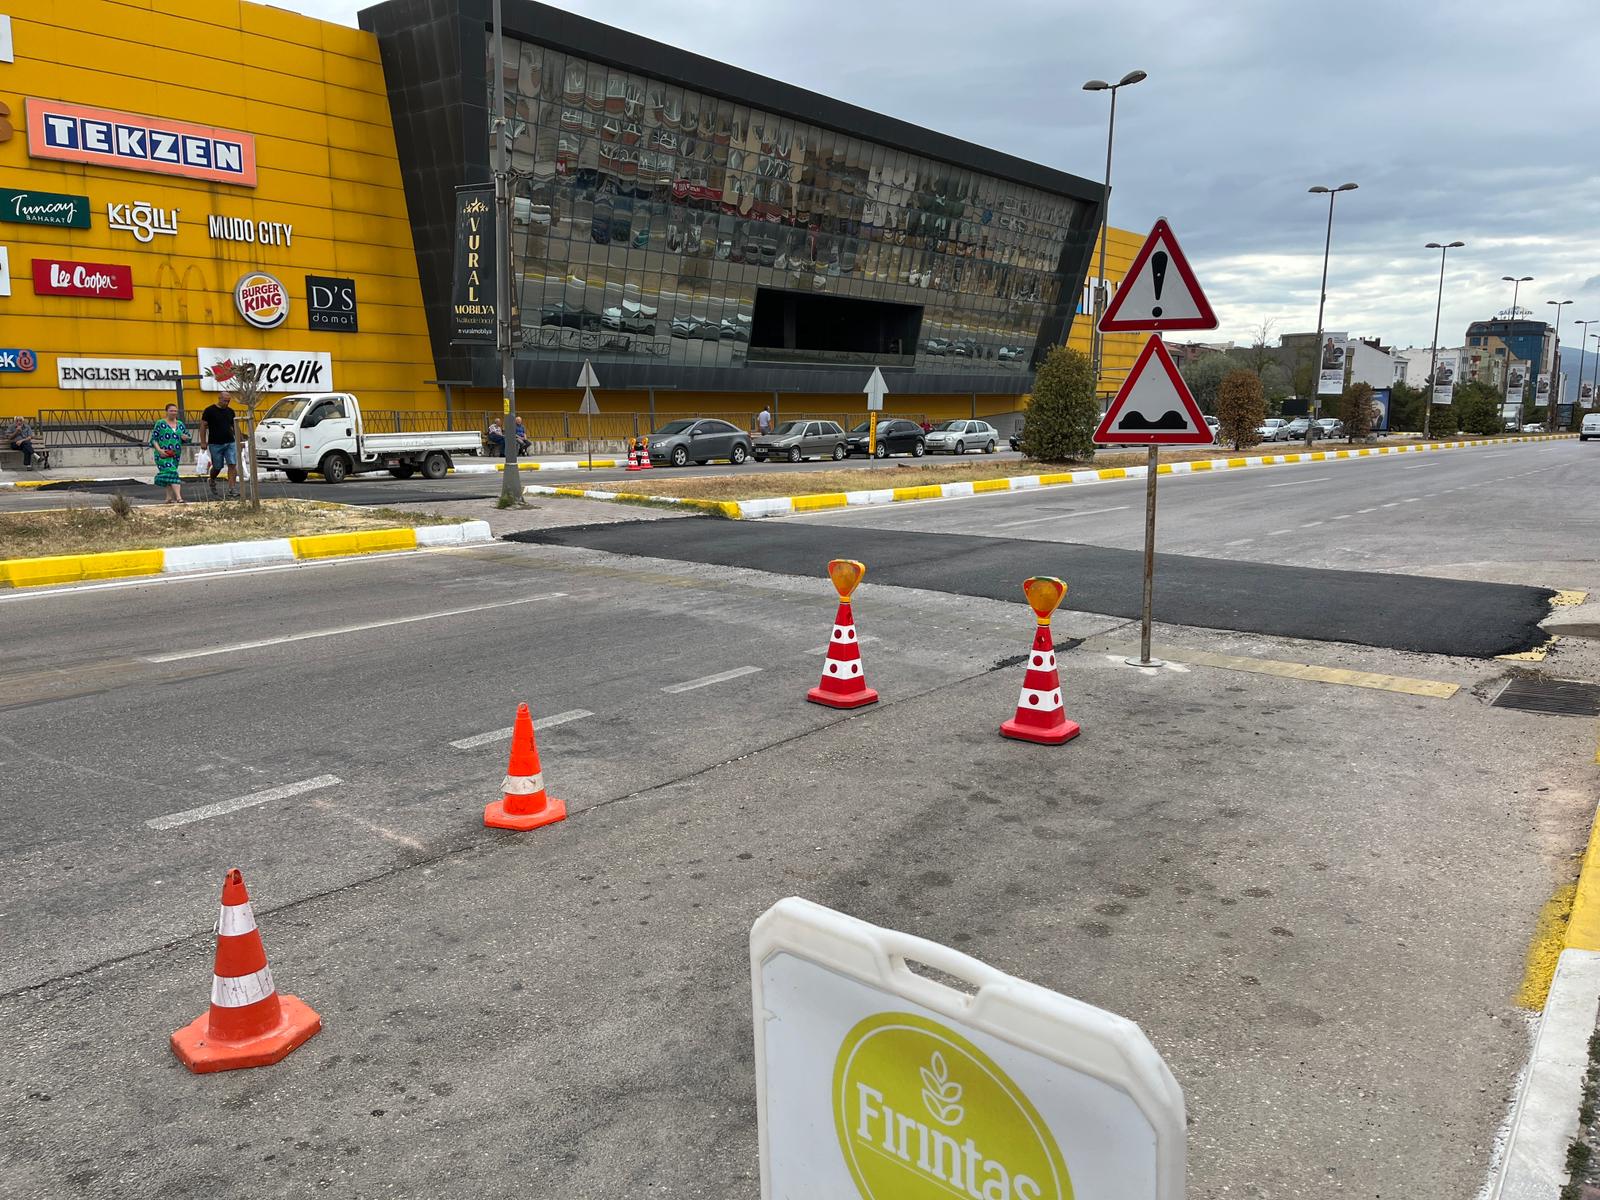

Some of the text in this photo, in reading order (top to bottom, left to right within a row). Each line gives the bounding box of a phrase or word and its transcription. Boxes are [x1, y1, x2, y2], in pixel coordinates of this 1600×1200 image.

[47, 116, 241, 171] TEKZEN
[11, 194, 78, 223] Tuncay
[26, 214, 66, 223] BAHARAT
[208, 214, 292, 247] MUDO CITY
[467, 216, 481, 302] VURAL
[50, 263, 118, 294] Lee Cooper
[242, 283, 280, 300] BURGER
[244, 292, 282, 313] KING
[311, 285, 354, 311] D'S
[312, 312, 354, 325] damat
[61, 366, 130, 381] ENGLISH
